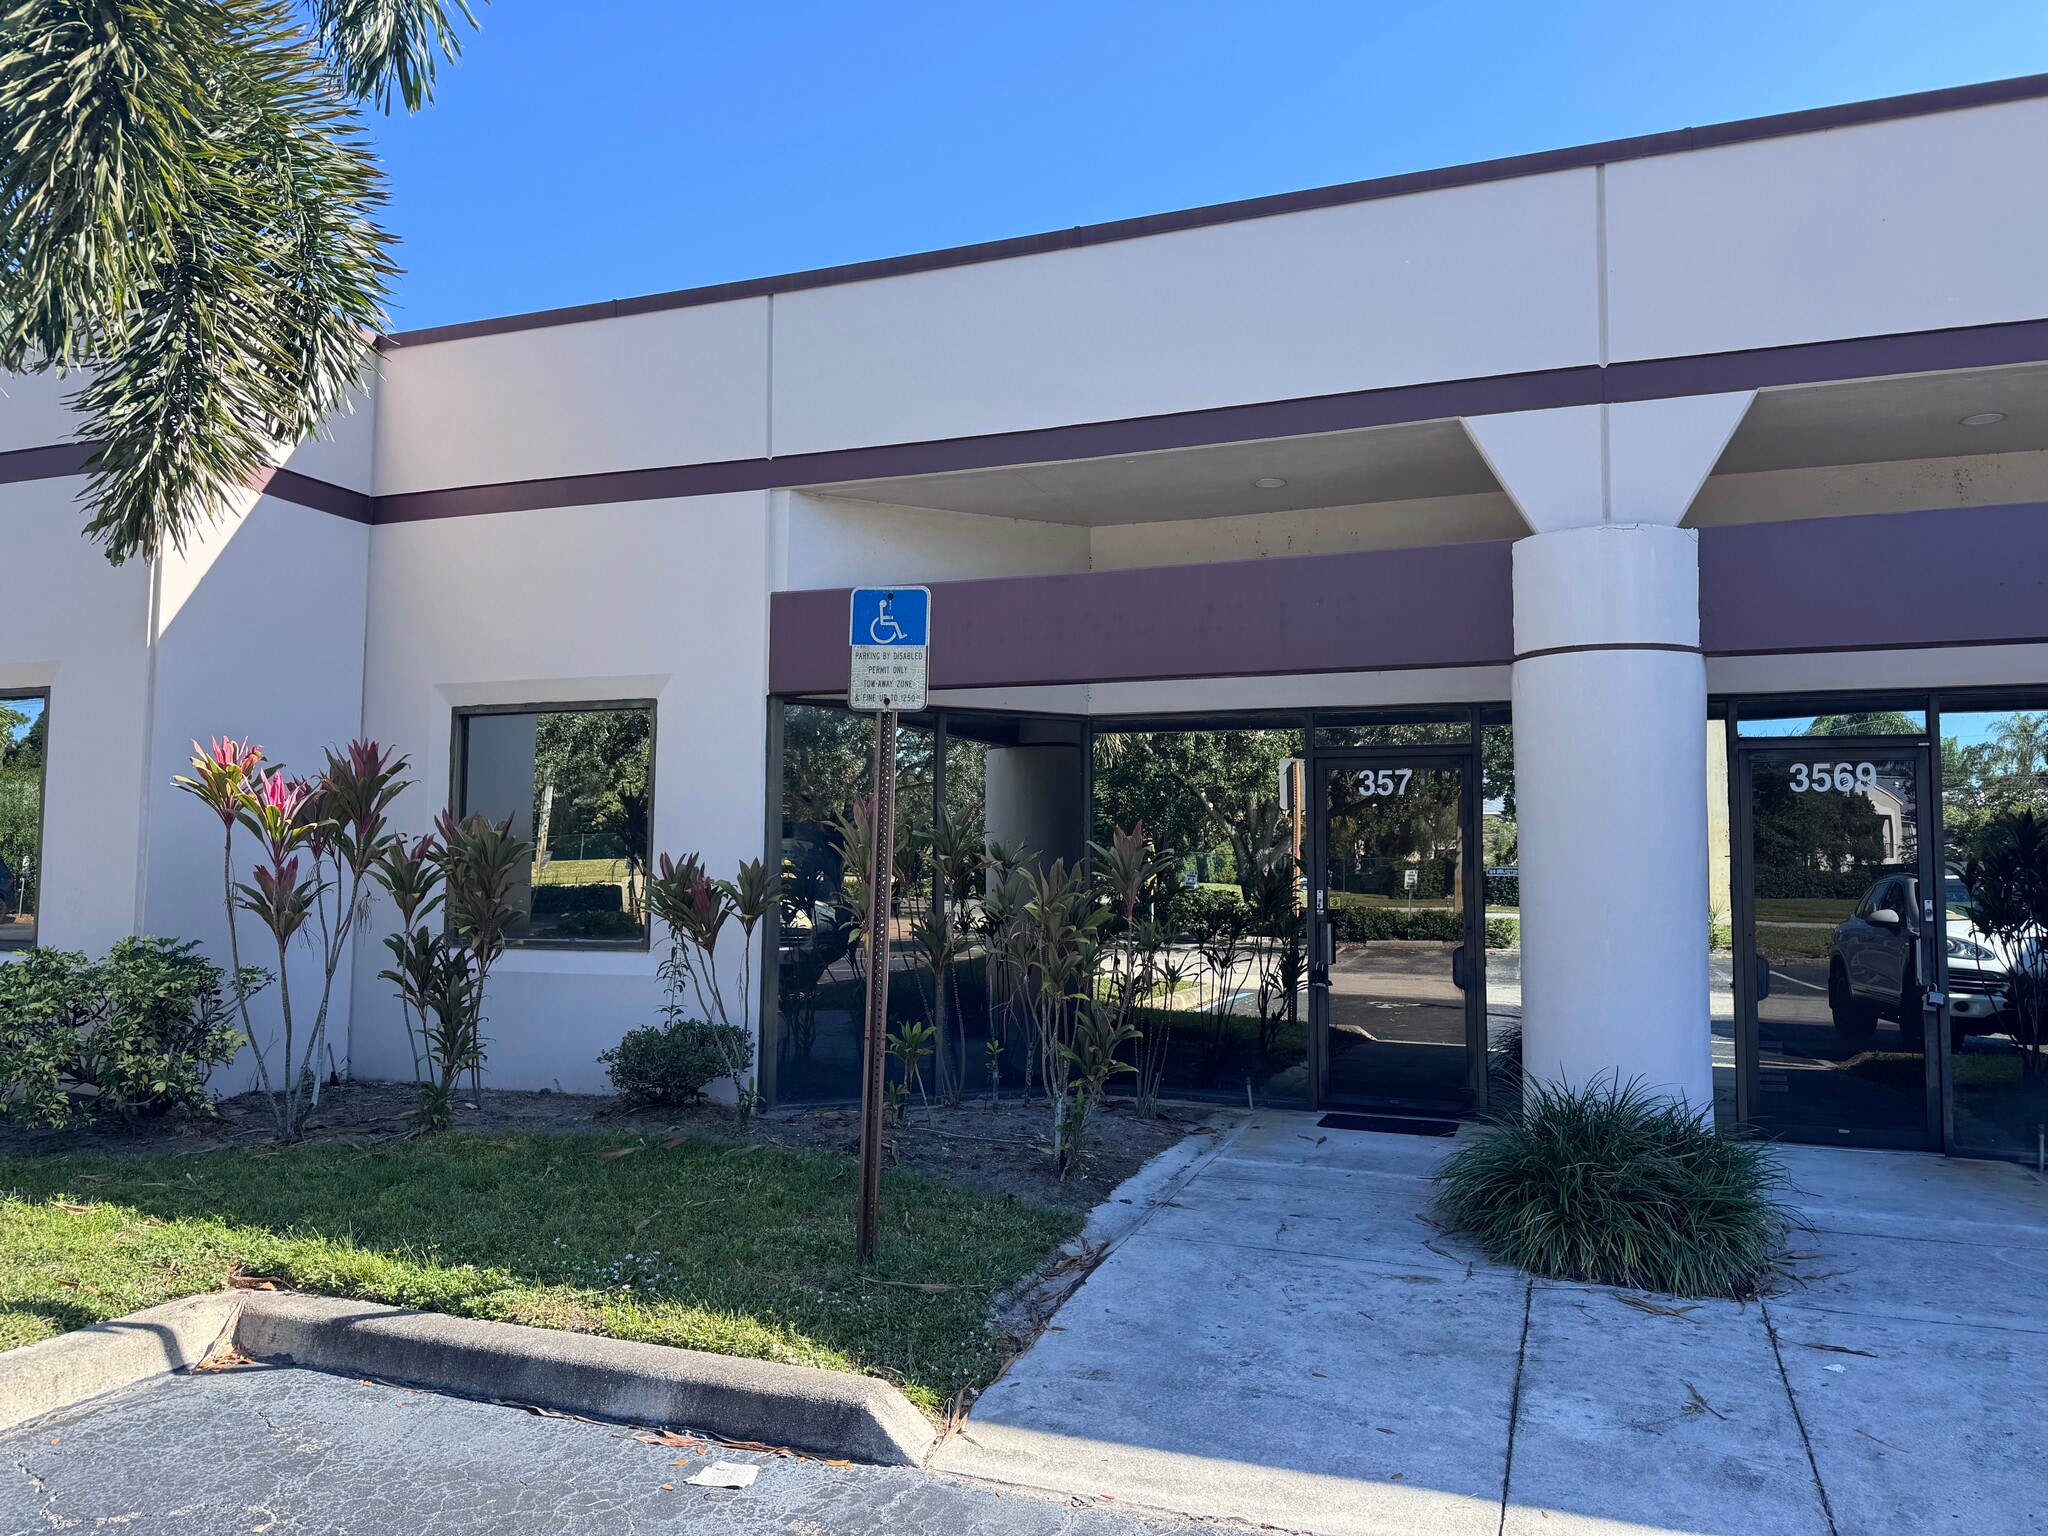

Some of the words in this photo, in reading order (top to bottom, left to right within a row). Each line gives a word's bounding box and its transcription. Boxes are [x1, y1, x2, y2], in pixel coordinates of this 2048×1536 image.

[855, 652, 880, 660] PARKING
[883, 652, 890, 660] BY
[893, 652, 923, 660] DISABLED
[868, 666, 890, 674] PERMIT
[892, 666, 908, 674] ONLY
[863, 680, 893, 688] TOW-AWAY
[896, 680, 912, 688] ZONE
[854, 694, 859, 702] &
[862, 694, 875, 702] FINE
[891, 694, 898, 702] TO
[1789, 762, 1877, 793] 3569
[1358, 769, 1413, 797] 357
